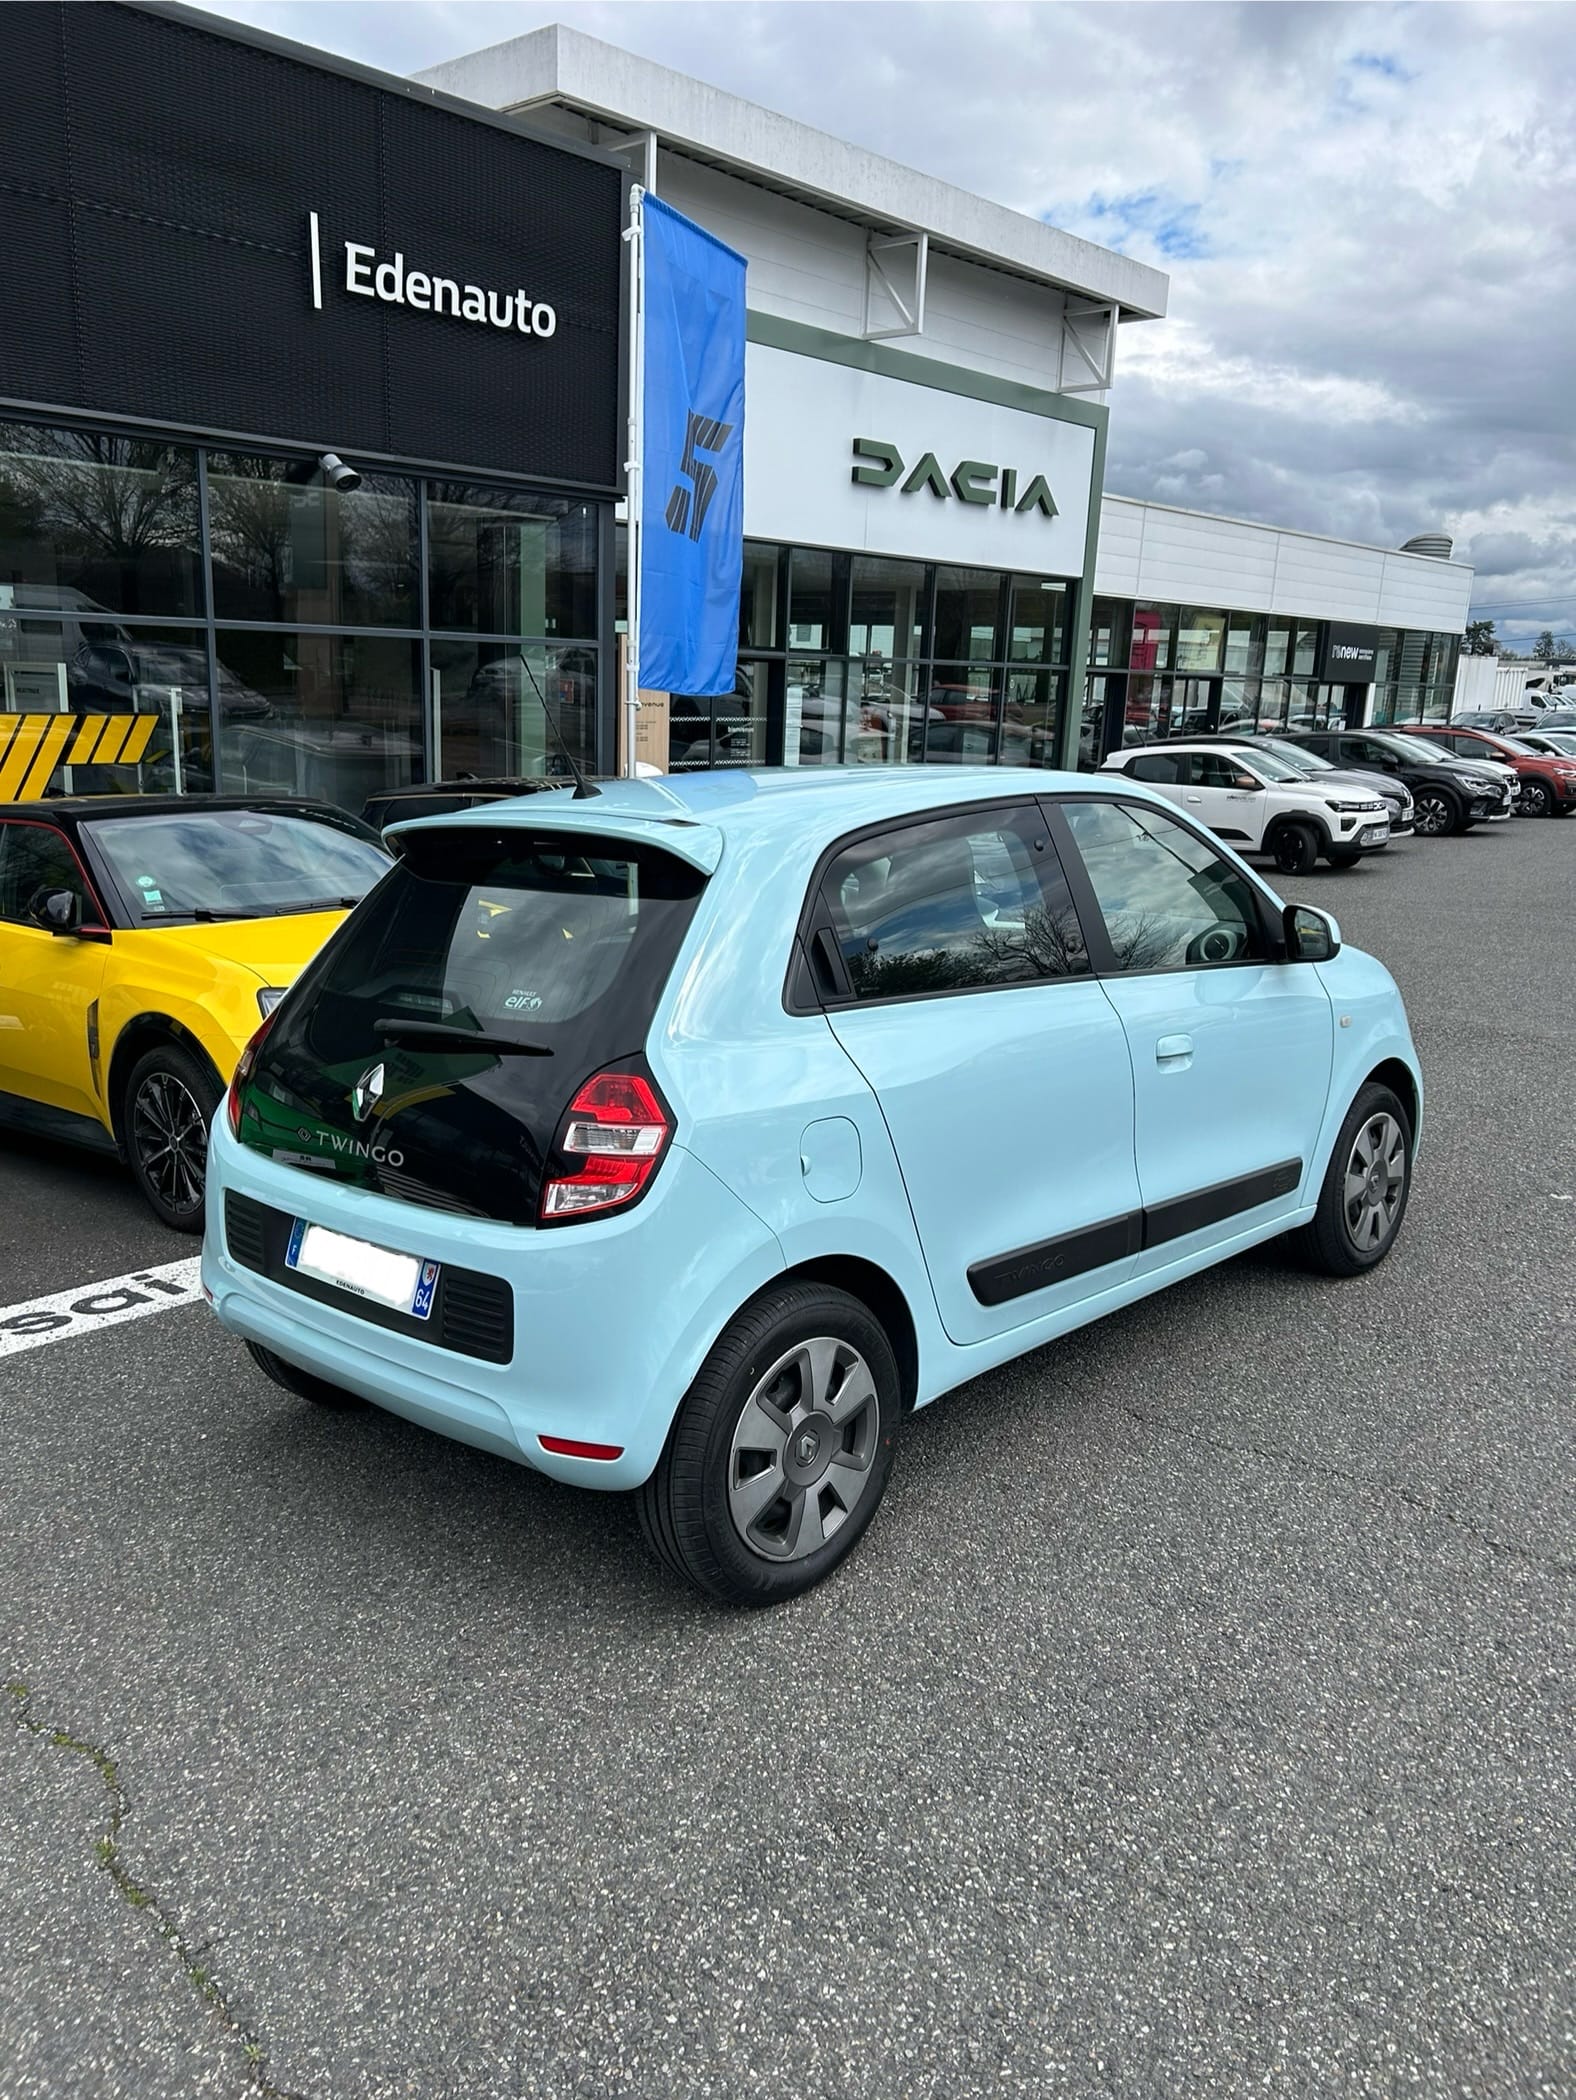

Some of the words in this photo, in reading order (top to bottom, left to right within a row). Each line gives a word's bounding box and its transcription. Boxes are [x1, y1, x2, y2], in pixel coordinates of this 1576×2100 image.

[344, 240, 557, 338] Edenauto
[851, 437, 1060, 517] DACIA
[316, 1130, 404, 1166] TWINGO
[336, 1279, 365, 1295] EDENAUTO
[415, 1288, 430, 1311] 64
